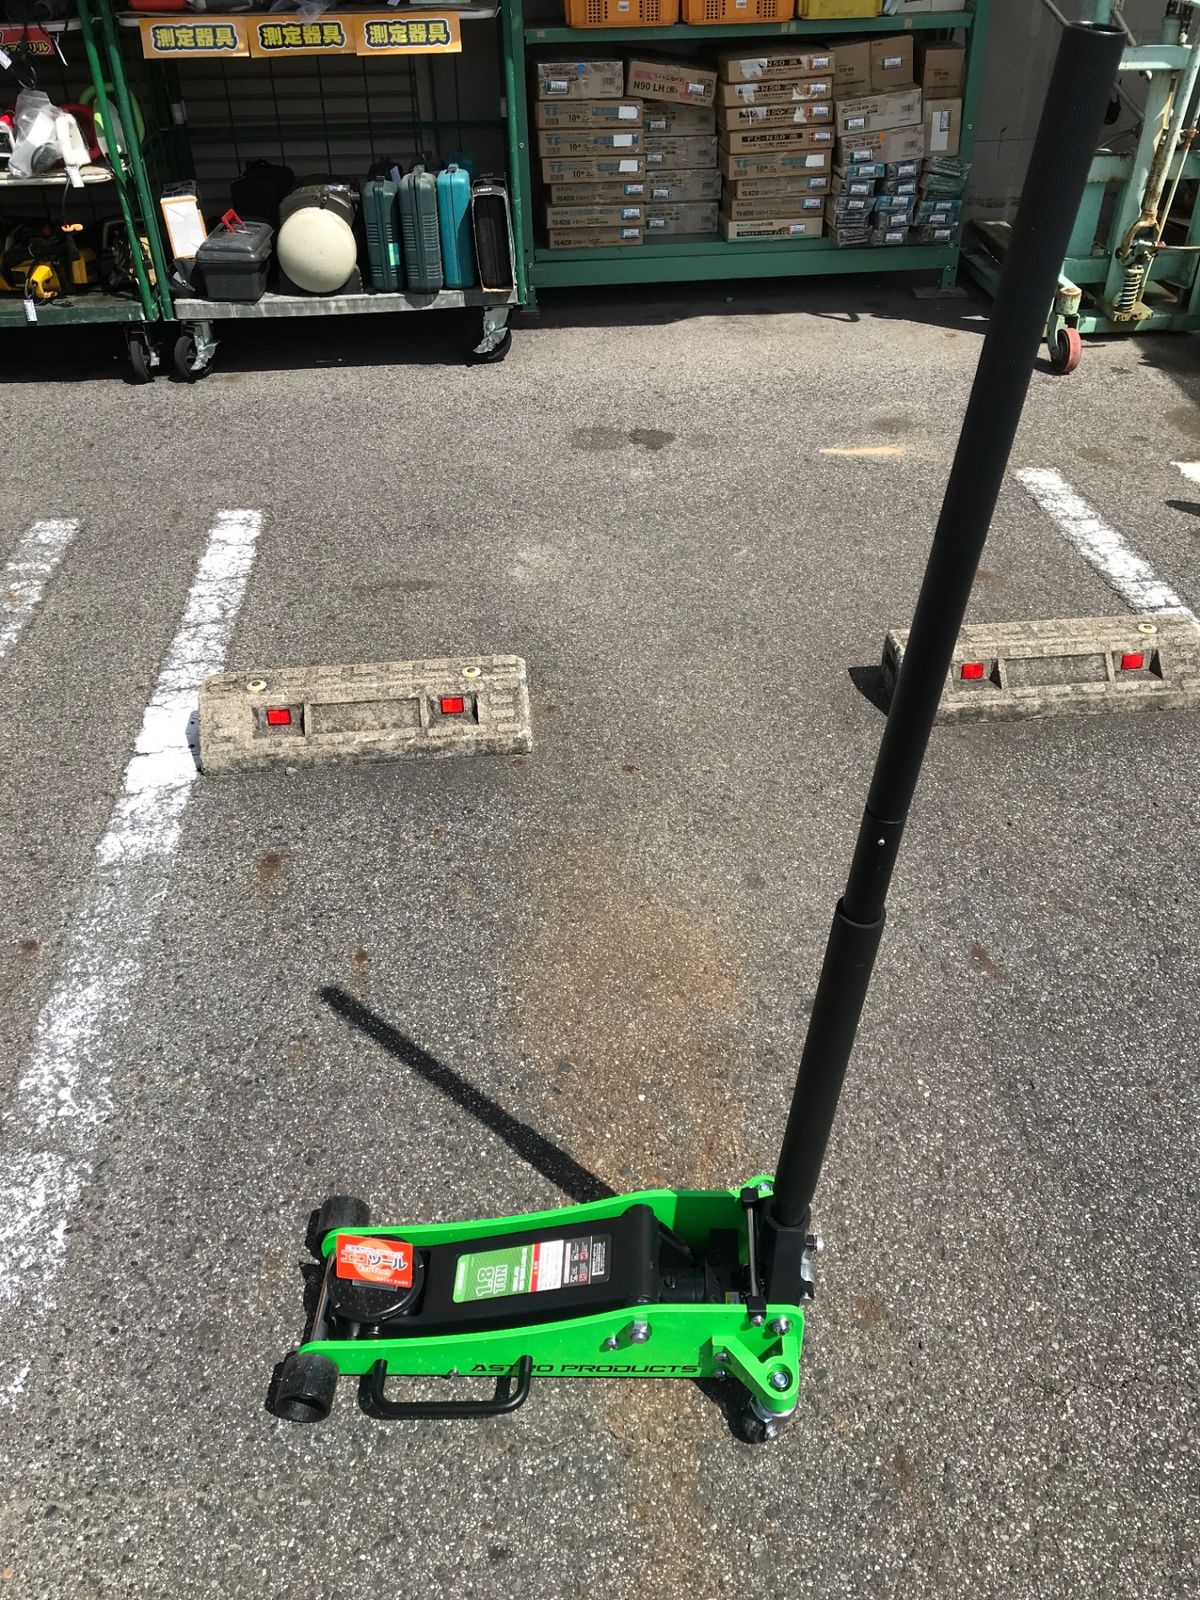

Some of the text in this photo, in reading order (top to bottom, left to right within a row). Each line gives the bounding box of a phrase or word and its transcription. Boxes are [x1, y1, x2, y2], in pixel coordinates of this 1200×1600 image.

[154, 28, 235, 48] 測定器具
[262, 23, 343, 46] 測定器具
[369, 22, 450, 44] 測定器具
[633, 81, 651, 91] N90
[340, 1250, 408, 1271] エコツール
[493, 1264, 508, 1294] TON
[471, 1364, 698, 1373] ASTO PRODUCTS
